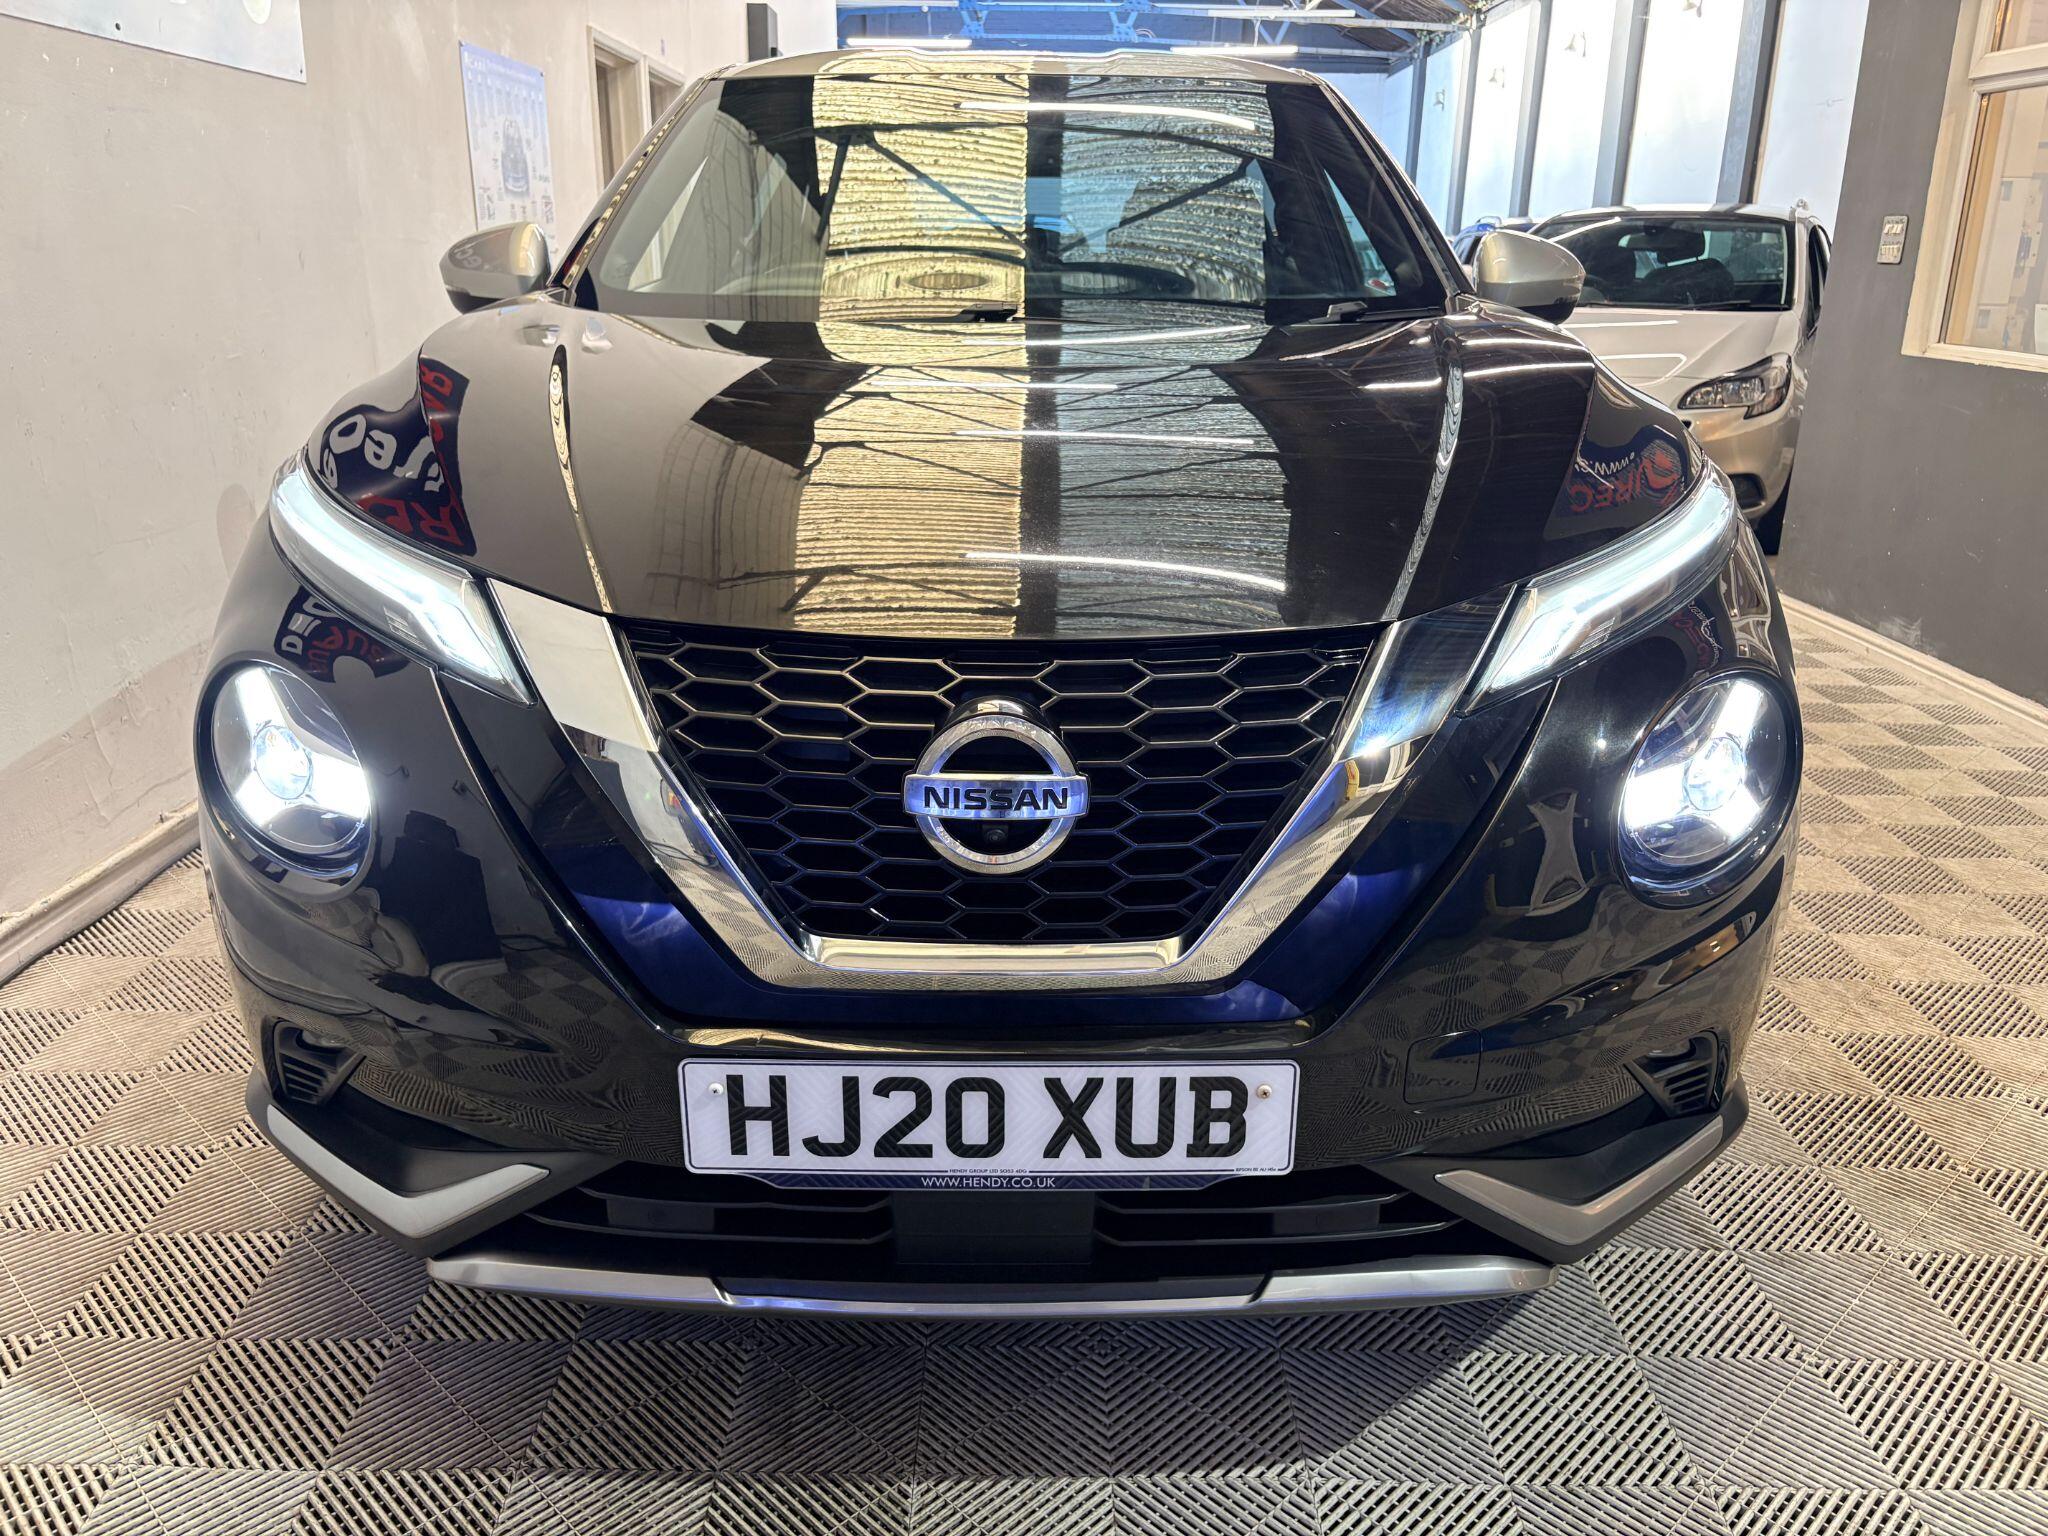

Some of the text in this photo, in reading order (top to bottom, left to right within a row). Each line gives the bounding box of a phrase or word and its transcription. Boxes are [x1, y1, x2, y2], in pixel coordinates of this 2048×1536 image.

[924, 786, 1068, 810] NISSAN
[725, 1074, 1248, 1159] HJ20 XUB
[921, 1177, 1056, 1189] WWW.HENDY.CO.UK
